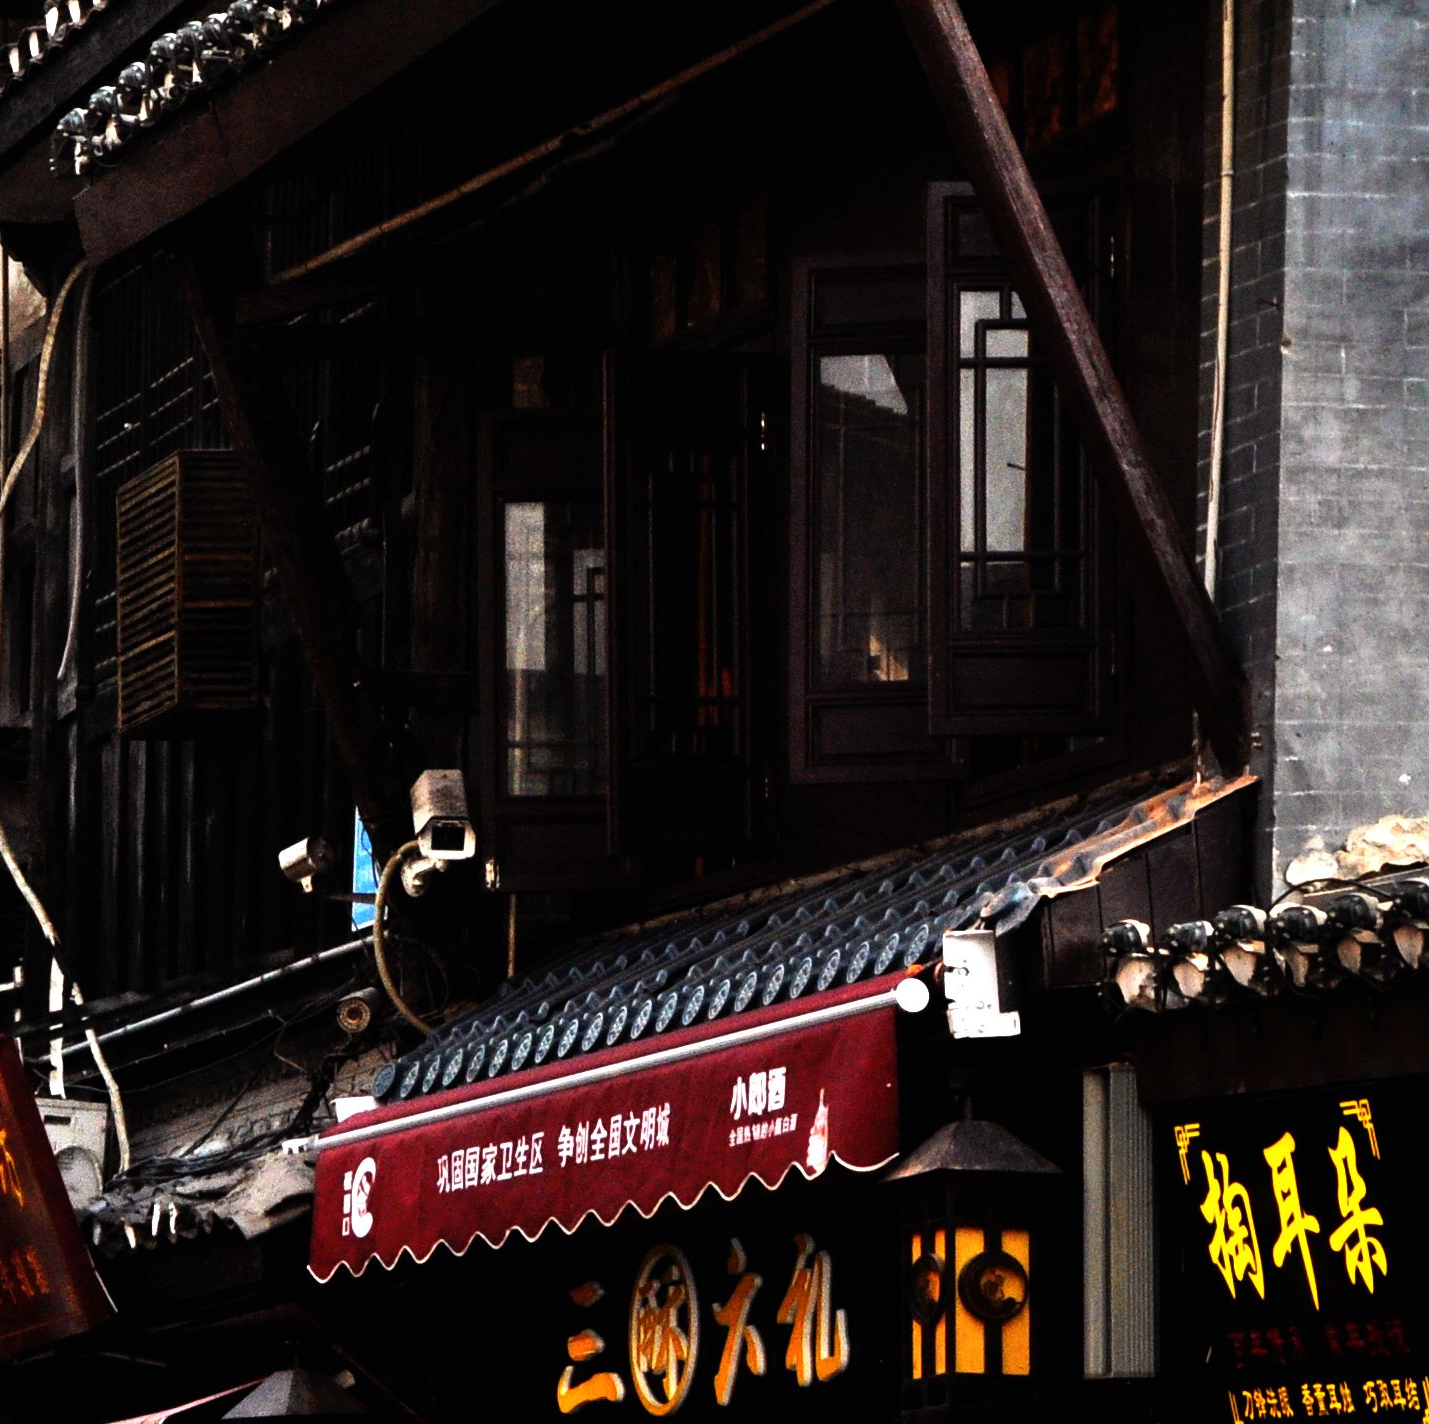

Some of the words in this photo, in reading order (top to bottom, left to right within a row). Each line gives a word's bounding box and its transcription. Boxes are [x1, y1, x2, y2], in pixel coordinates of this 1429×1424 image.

[436, 1130, 545, 1194] 巩固国家卫生区
[557, 1102, 671, 1168] 争创全国文明城
[1200, 1127, 1388, 1311] 掏耳朵
